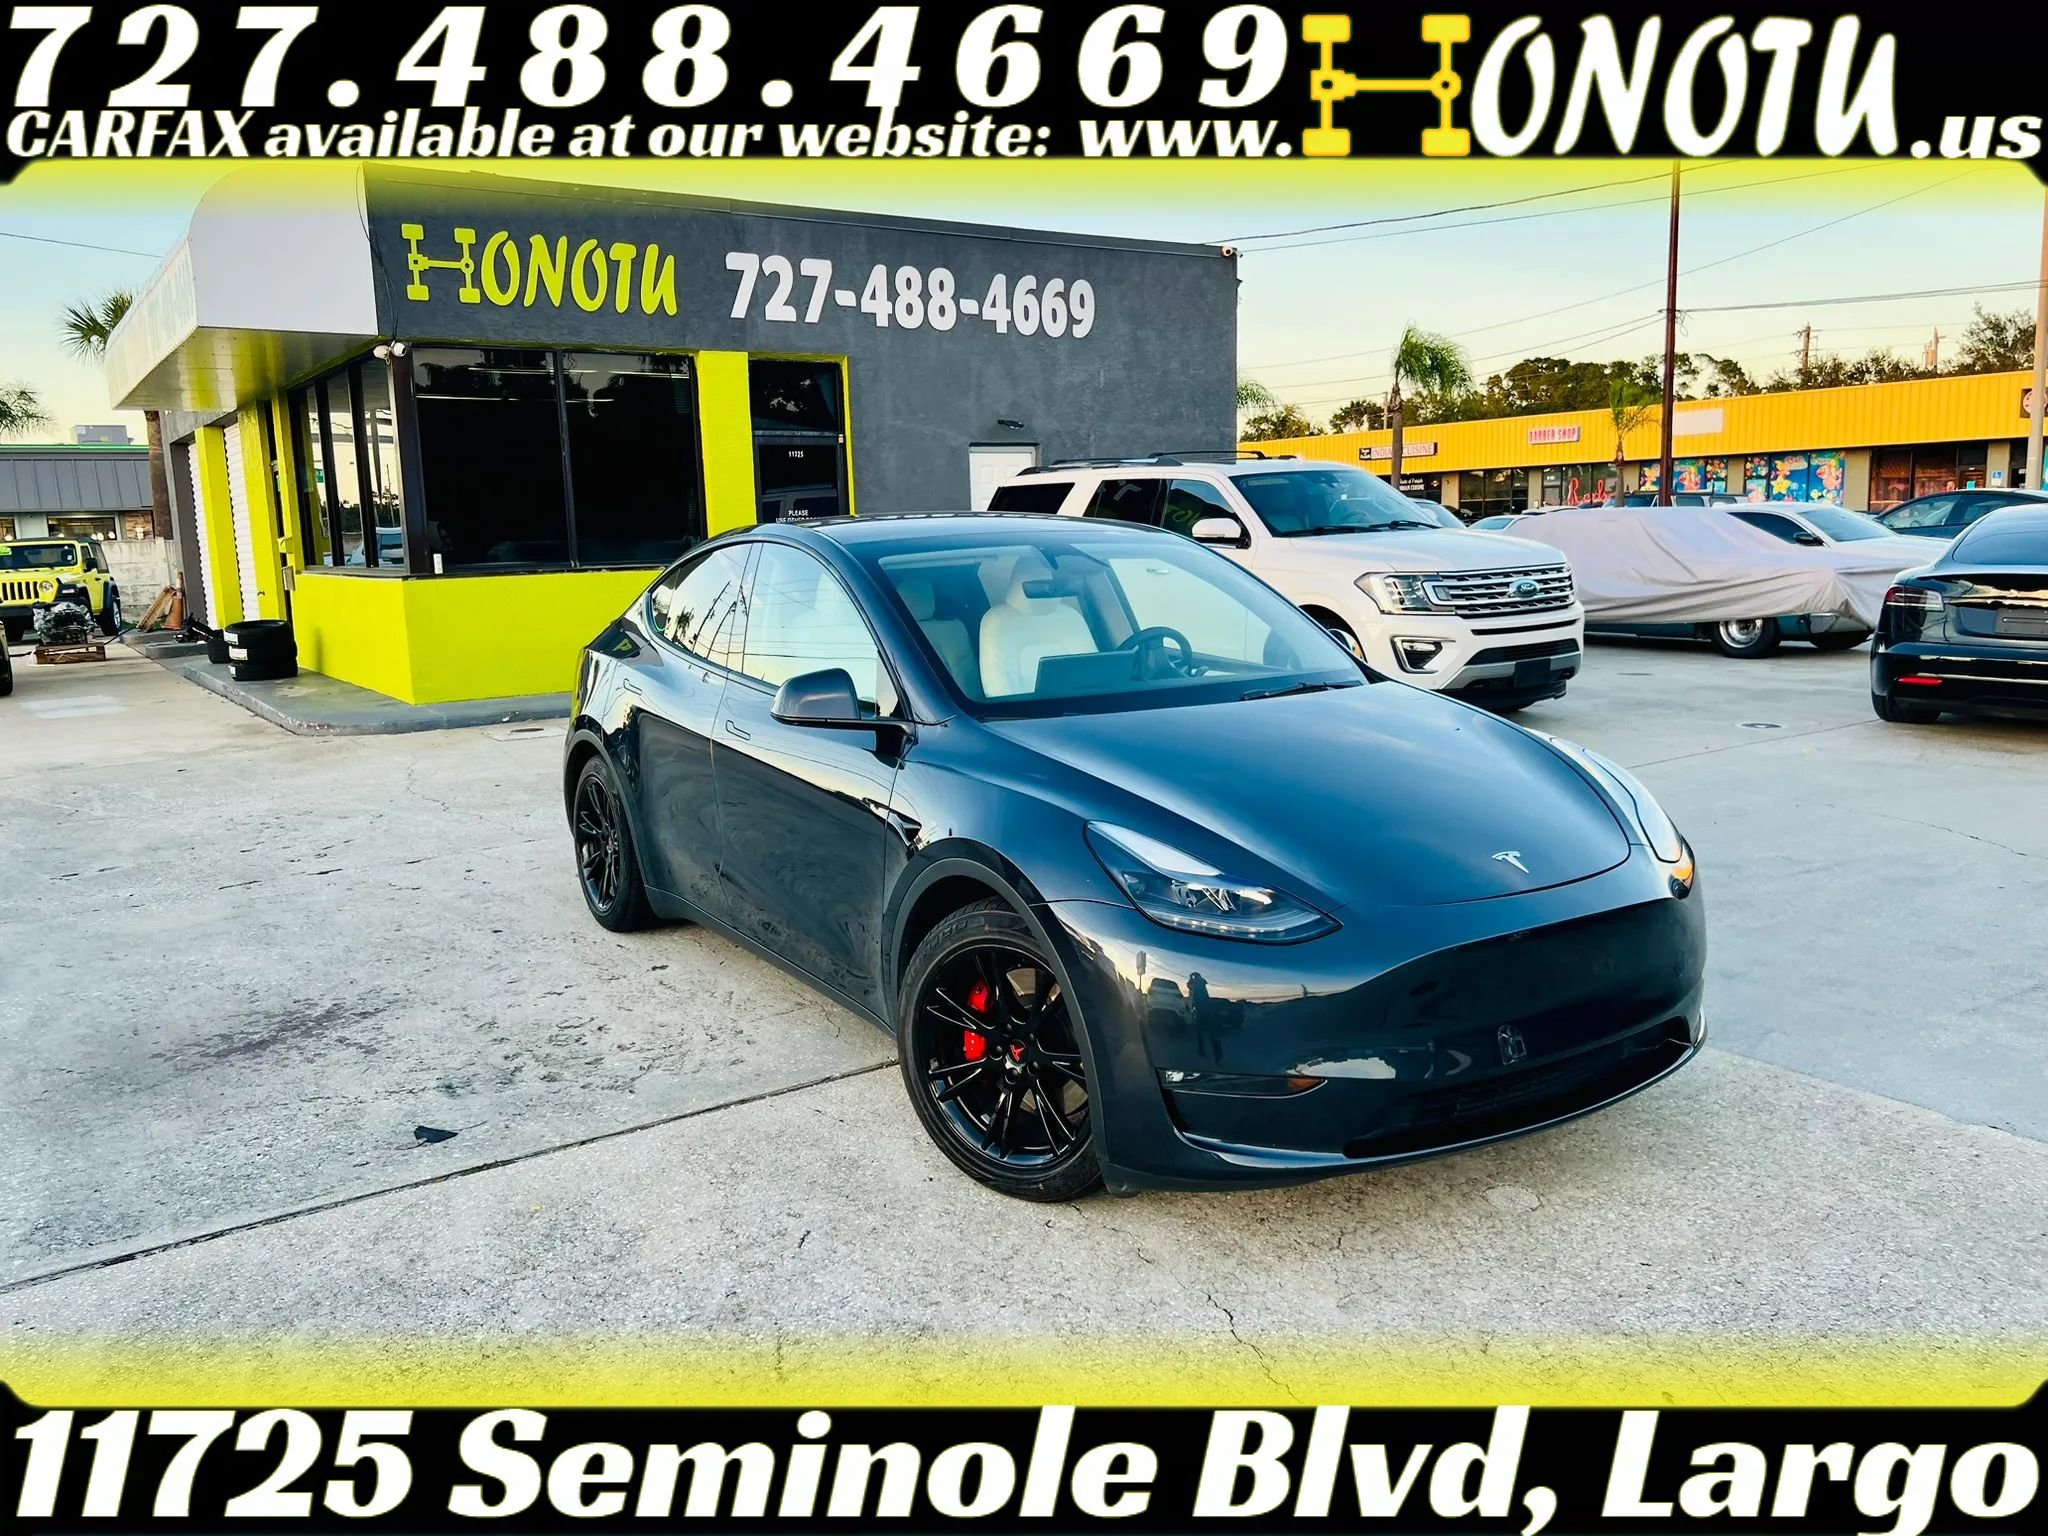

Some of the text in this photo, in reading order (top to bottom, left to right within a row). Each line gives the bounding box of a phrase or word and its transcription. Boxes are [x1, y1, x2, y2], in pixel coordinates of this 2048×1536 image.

[402, 223, 678, 316] HONOTU
[725, 251, 1096, 340] 727-488-4669
[1529, 427, 1576, 442] BARBER SHOP
[1372, 447, 1393, 458] INDIA
[1403, 443, 1433, 456] CUISINE
[788, 509, 808, 517] PLEASE
